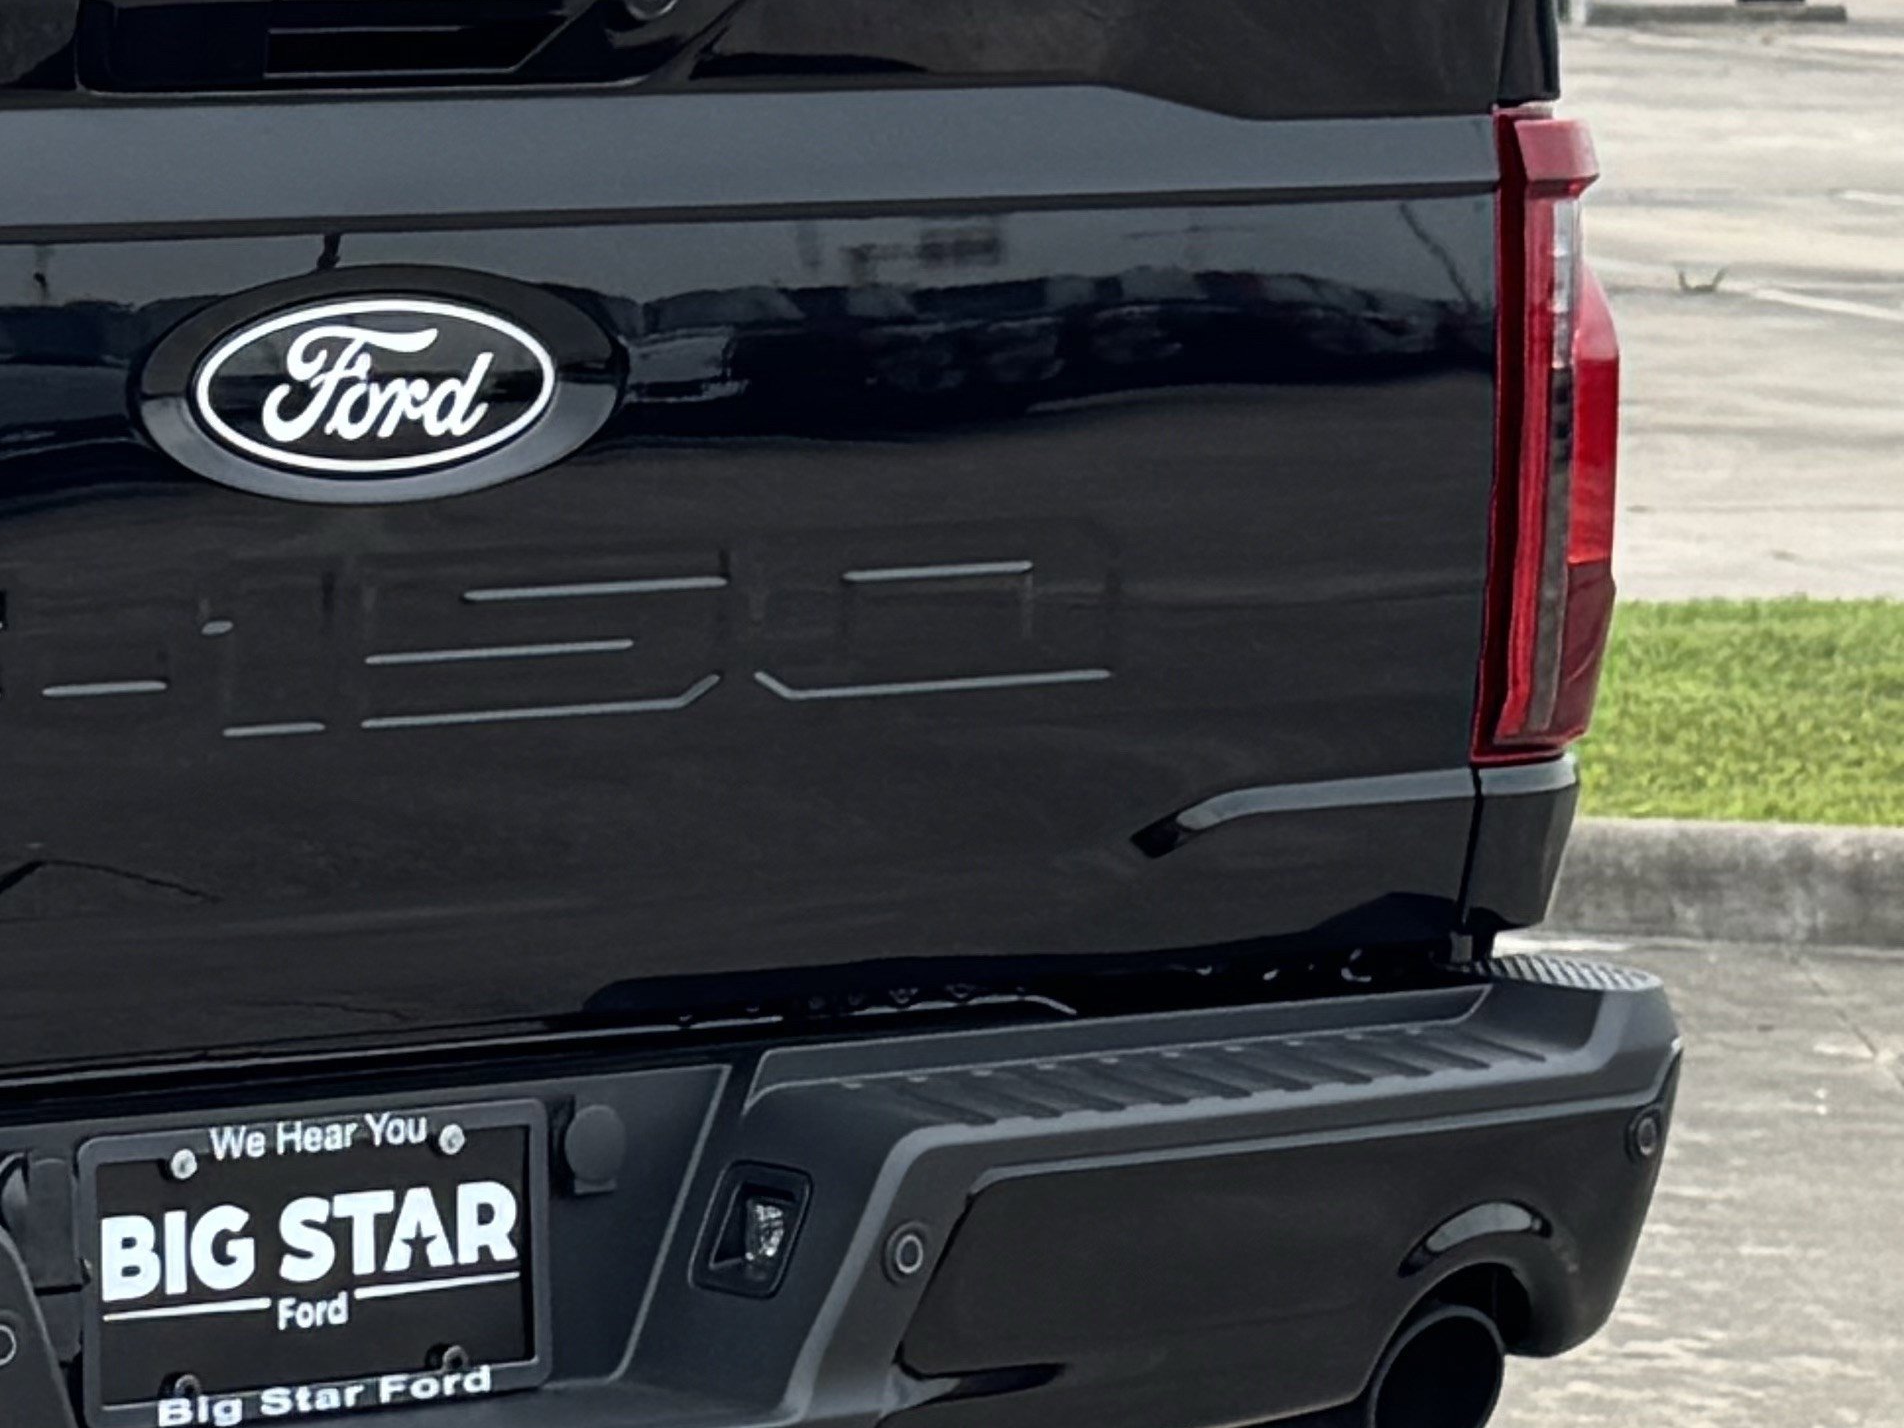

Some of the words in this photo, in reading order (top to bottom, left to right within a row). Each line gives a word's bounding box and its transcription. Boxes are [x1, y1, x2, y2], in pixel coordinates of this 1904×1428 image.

[262, 325, 493, 442] Ford
[209, 1125, 265, 1160] We
[275, 1119, 358, 1153] Hear
[364, 1112, 428, 1145] You
[100, 1204, 256, 1302] BIG
[278, 1180, 519, 1283] STAR
[277, 1292, 349, 1330] Ford
[156, 1395, 243, 1428] Big
[259, 1384, 364, 1418] Star
[378, 1366, 492, 1404] Ford
